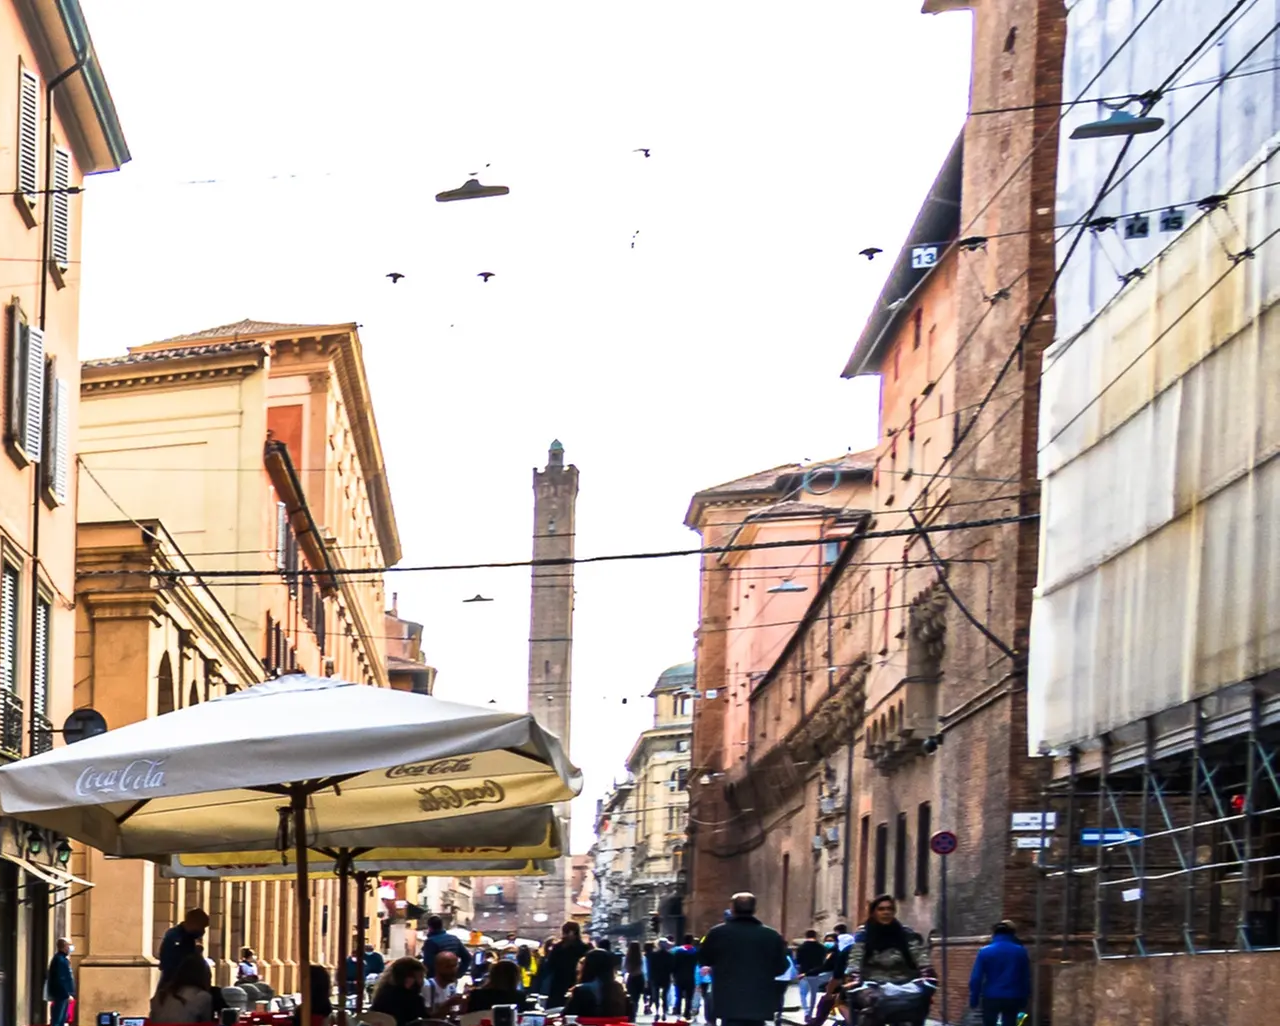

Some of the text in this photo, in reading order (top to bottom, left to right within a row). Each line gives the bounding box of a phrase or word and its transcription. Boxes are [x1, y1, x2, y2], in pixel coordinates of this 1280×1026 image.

[1125, 222, 1149, 236] 14
[1160, 216, 1183, 230] 15
[913, 252, 935, 265] 13
